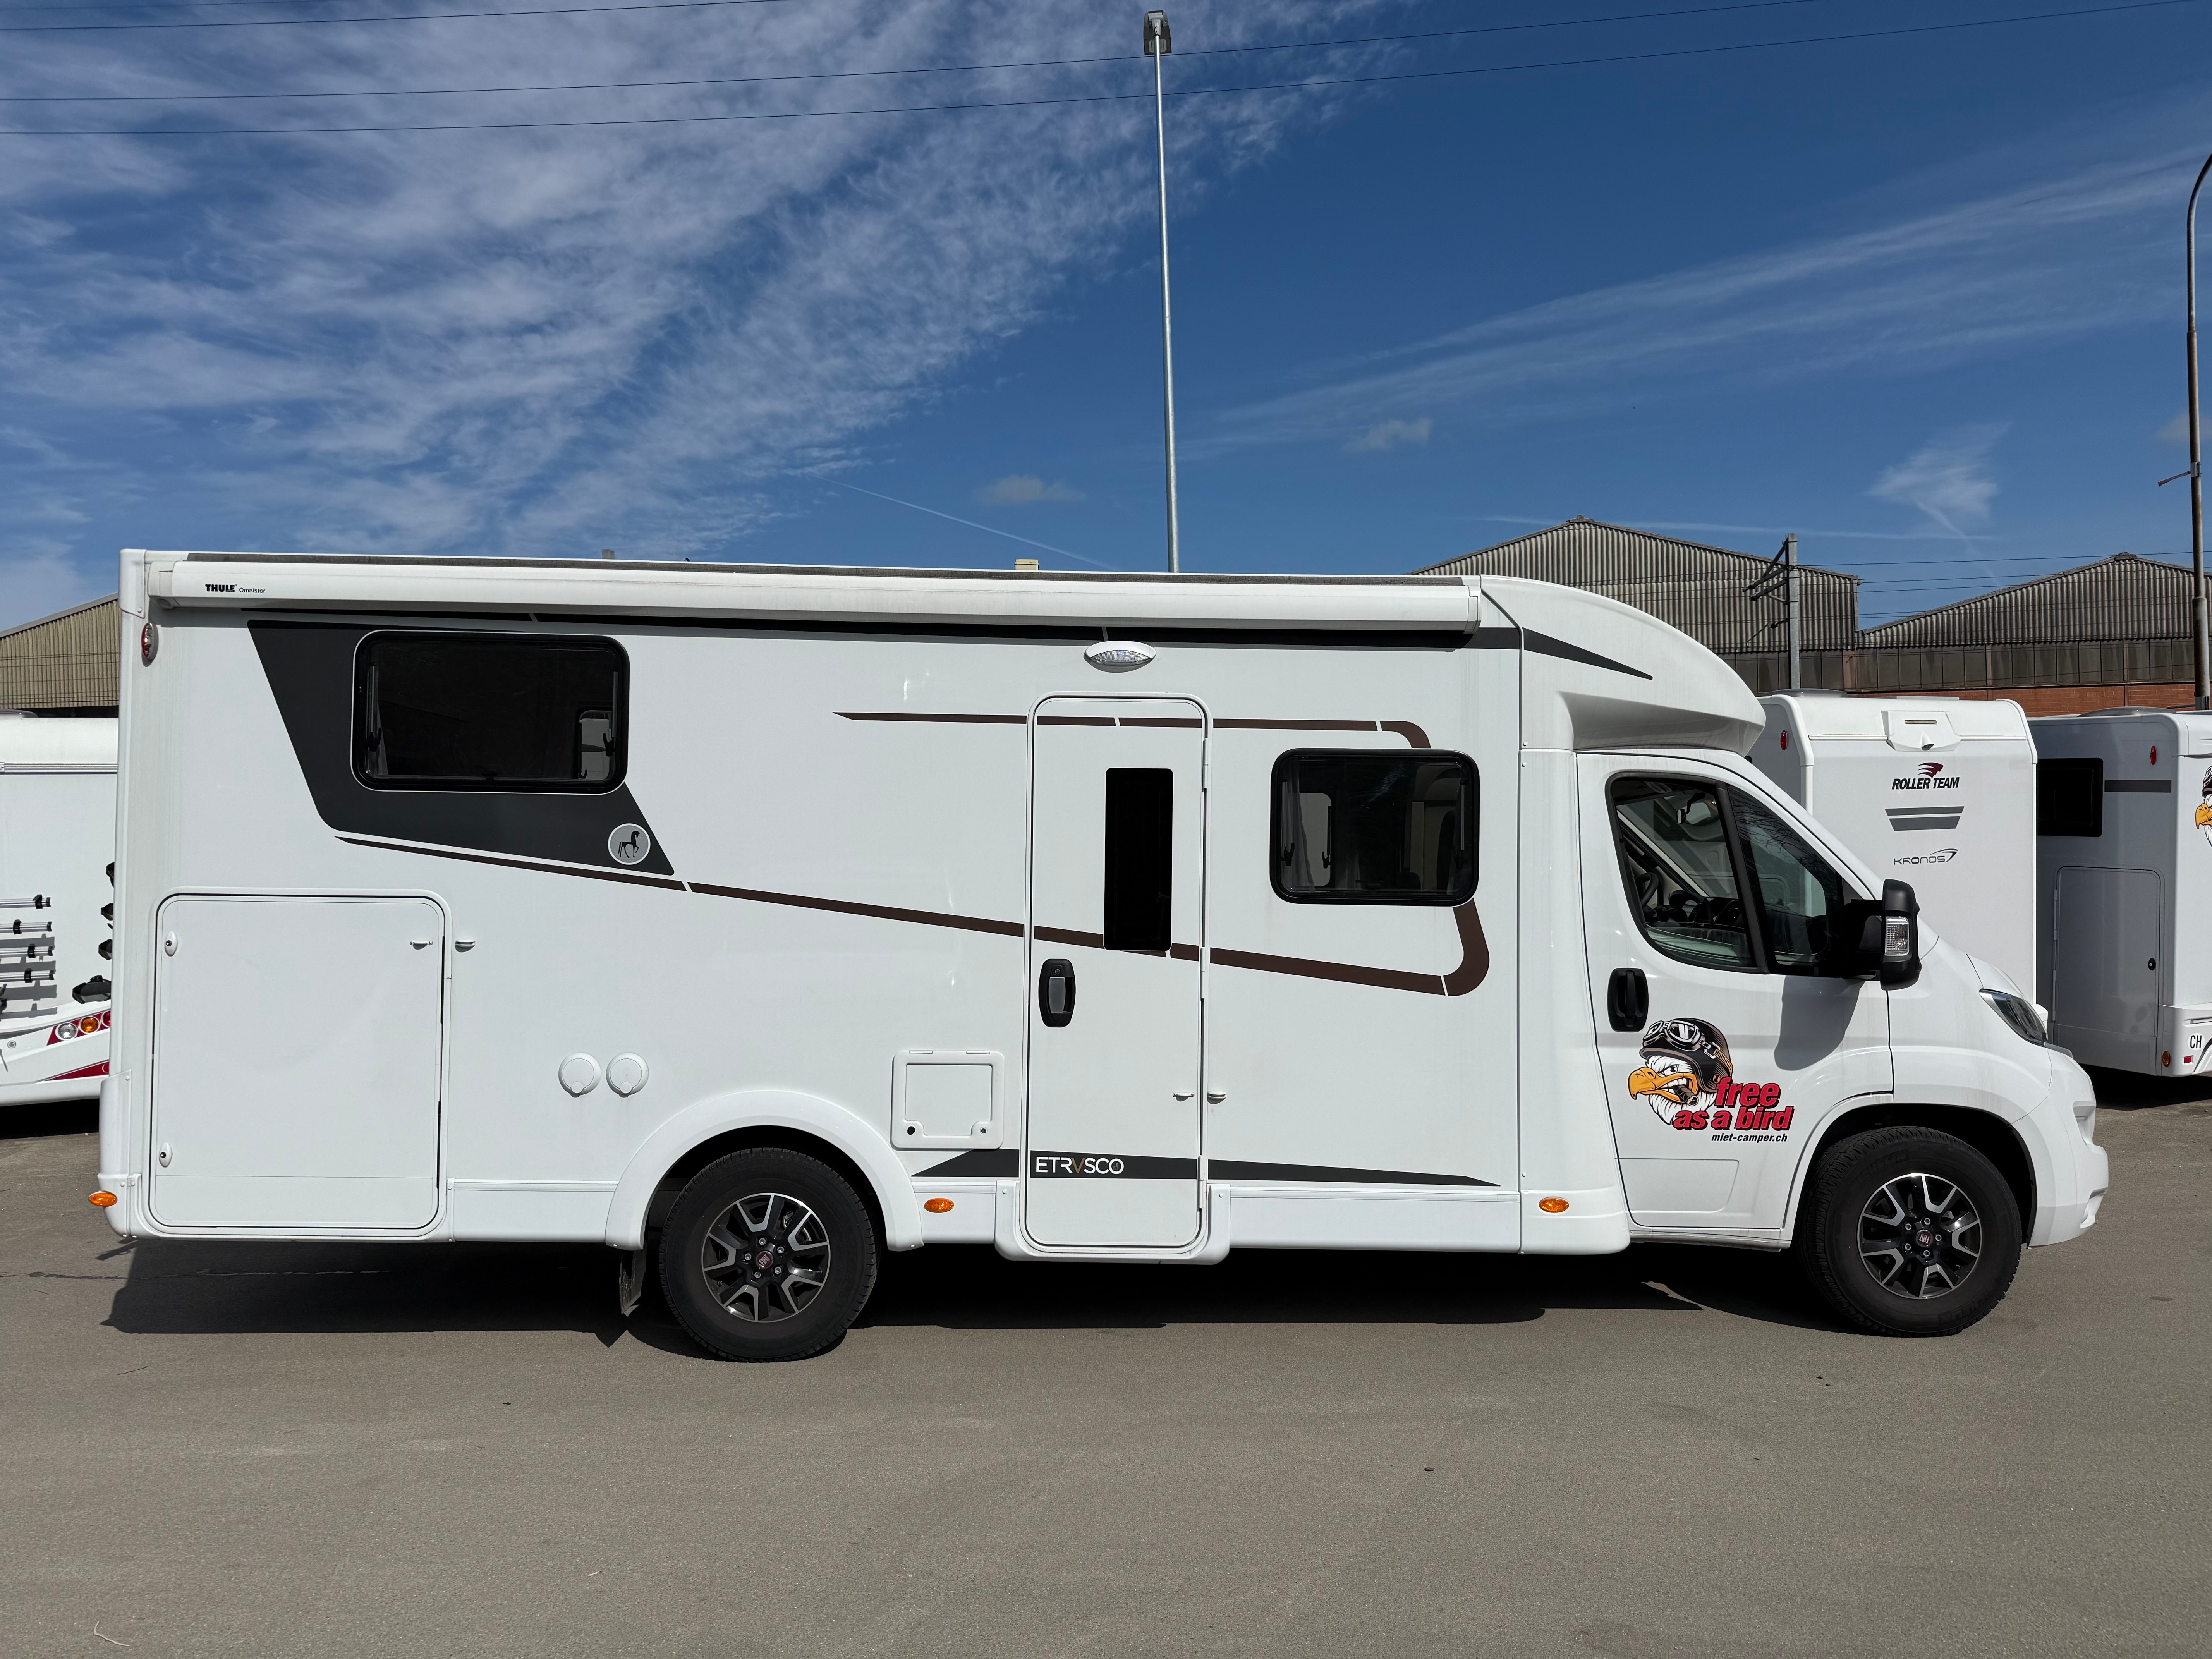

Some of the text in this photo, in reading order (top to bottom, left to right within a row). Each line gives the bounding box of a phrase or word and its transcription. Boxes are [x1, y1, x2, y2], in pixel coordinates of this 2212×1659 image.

[205, 584, 235, 592] THULE
[1891, 777, 1960, 790] ROLLER TEAM
[1894, 855, 1946, 865] KRONOS
[2190, 1035, 2202, 1049] CH
[1714, 1077, 1781, 1108] free
[1672, 1106, 1795, 1131] as a bird
[1711, 1133, 1788, 1144] miet-camper.ch
[1918, 1233, 1930, 1243] FIAT
[758, 1254, 770, 1266] FIAT
